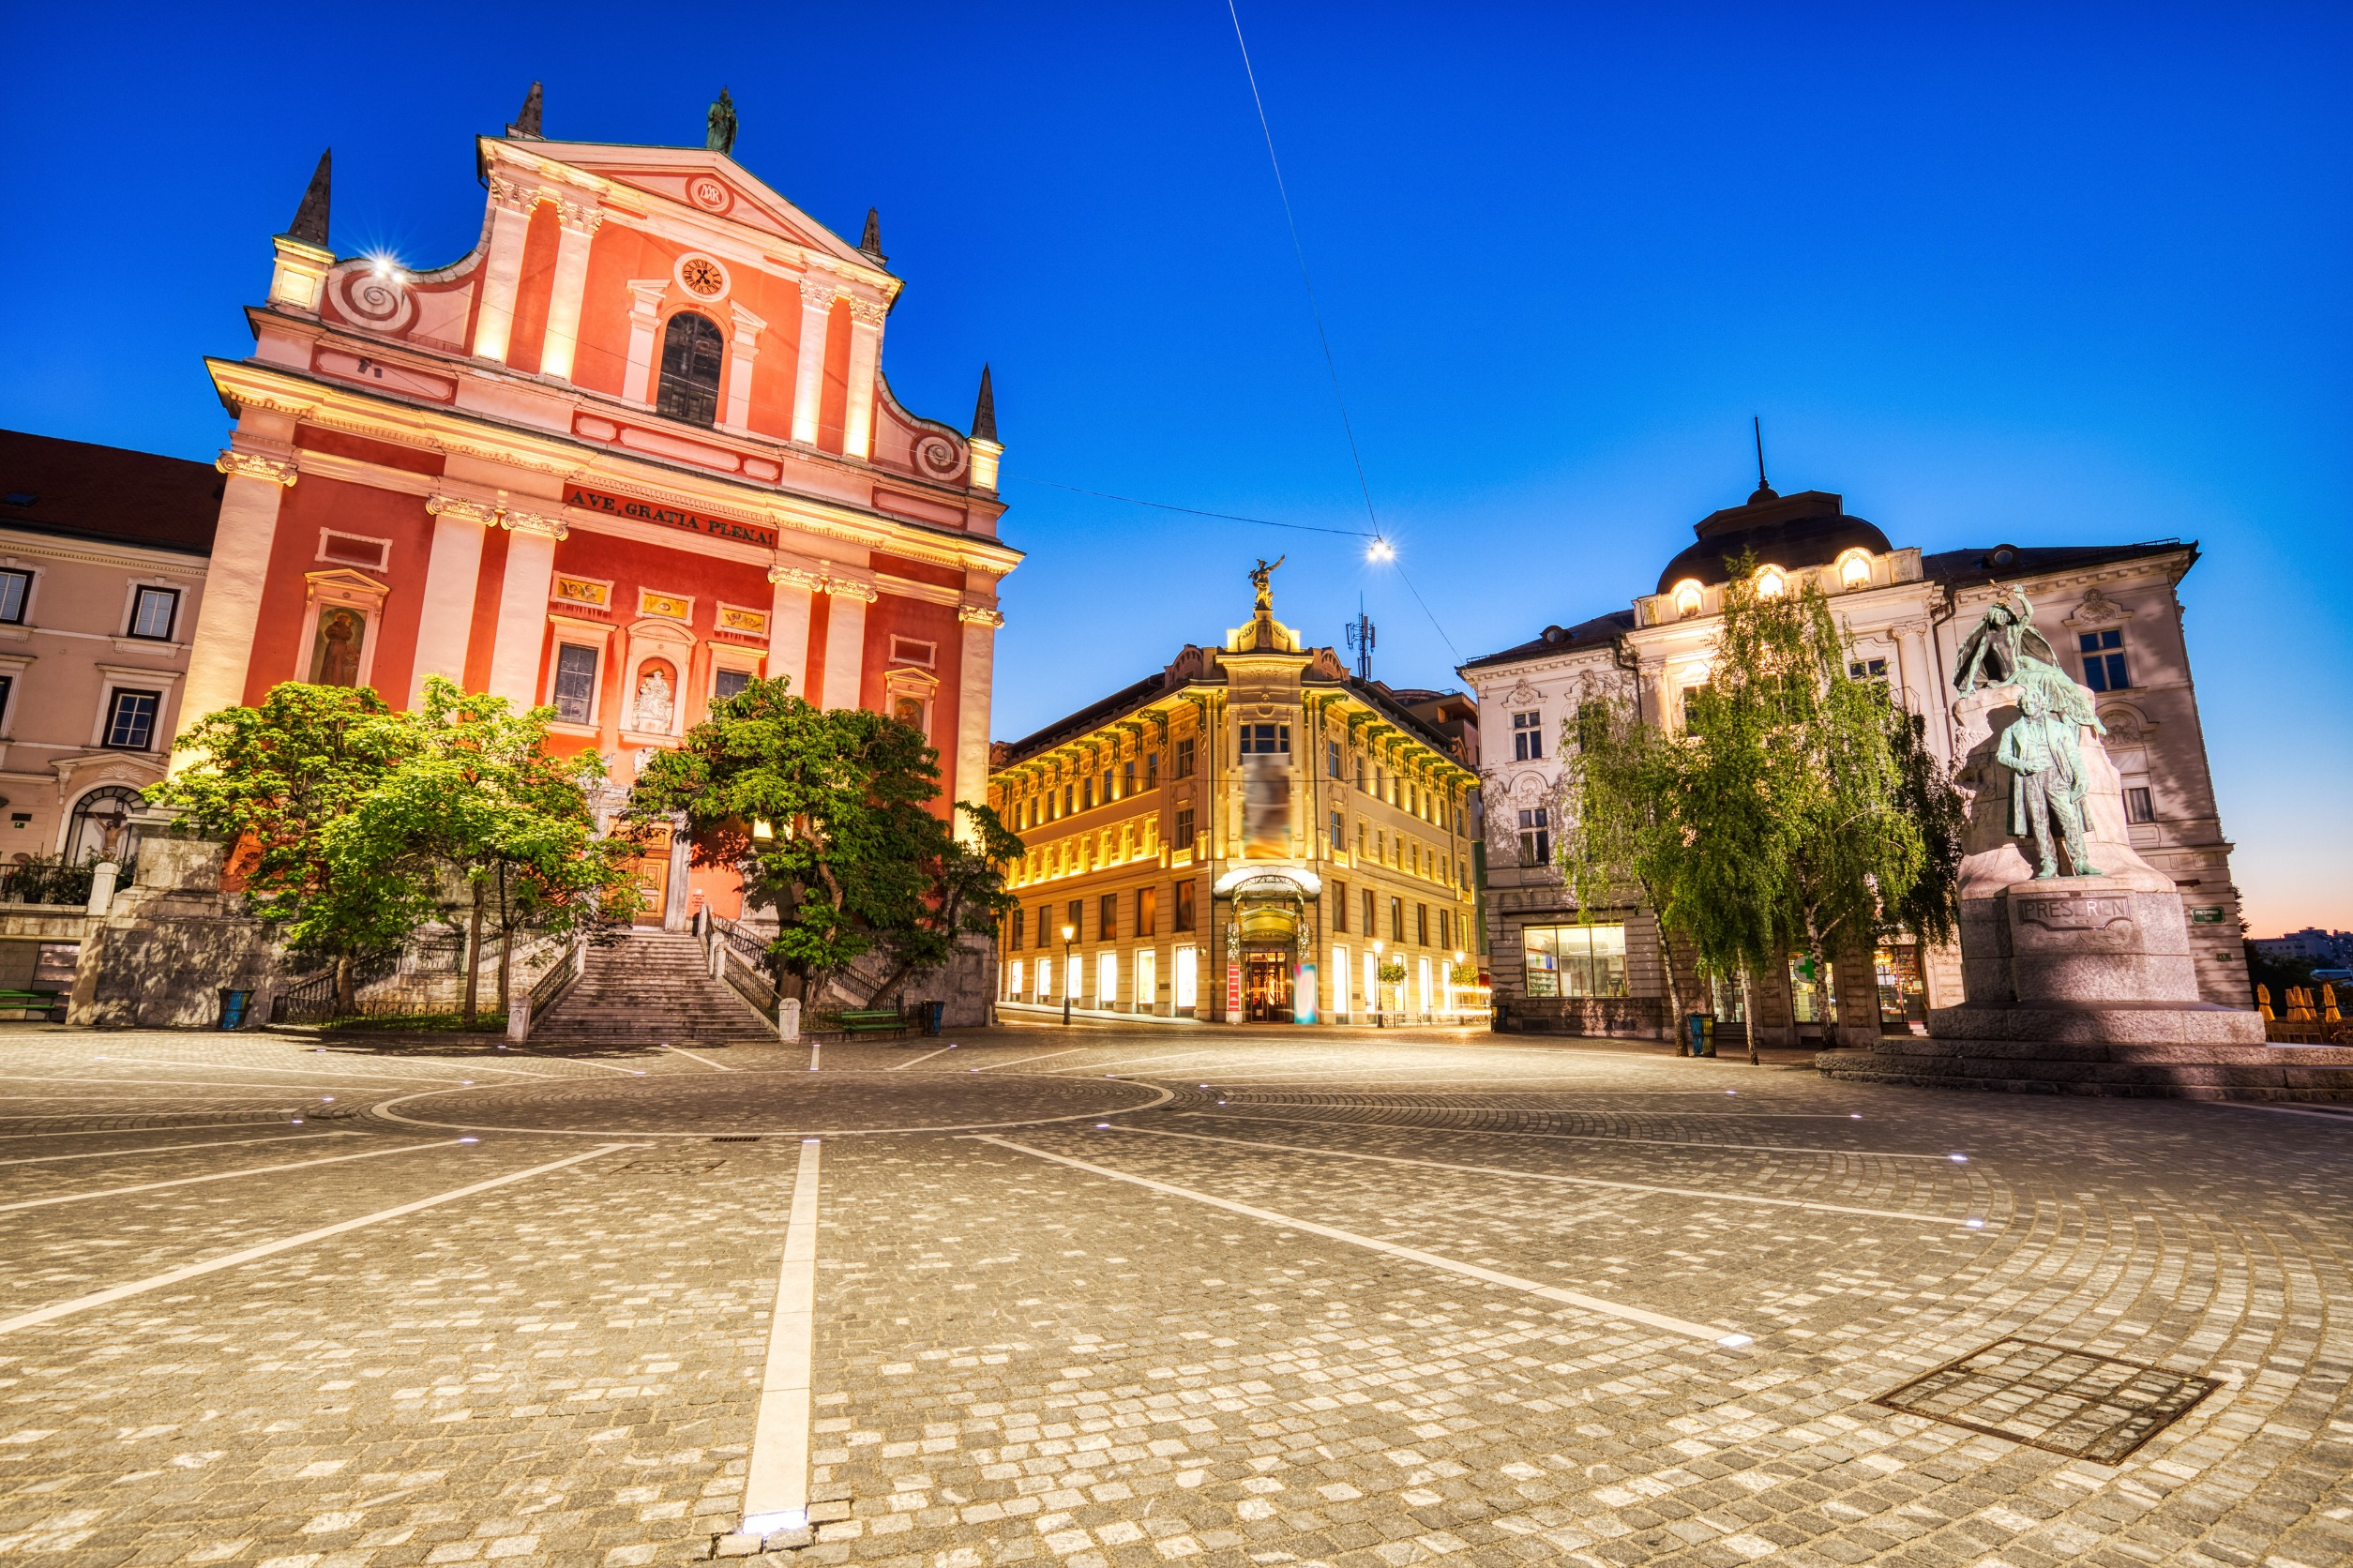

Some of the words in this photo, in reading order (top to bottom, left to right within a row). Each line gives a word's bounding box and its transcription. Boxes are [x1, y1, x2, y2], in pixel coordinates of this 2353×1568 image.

[570, 490, 622, 517] AVE,
[625, 503, 700, 529] GRATIA
[708, 520, 774, 546] PLENA!
